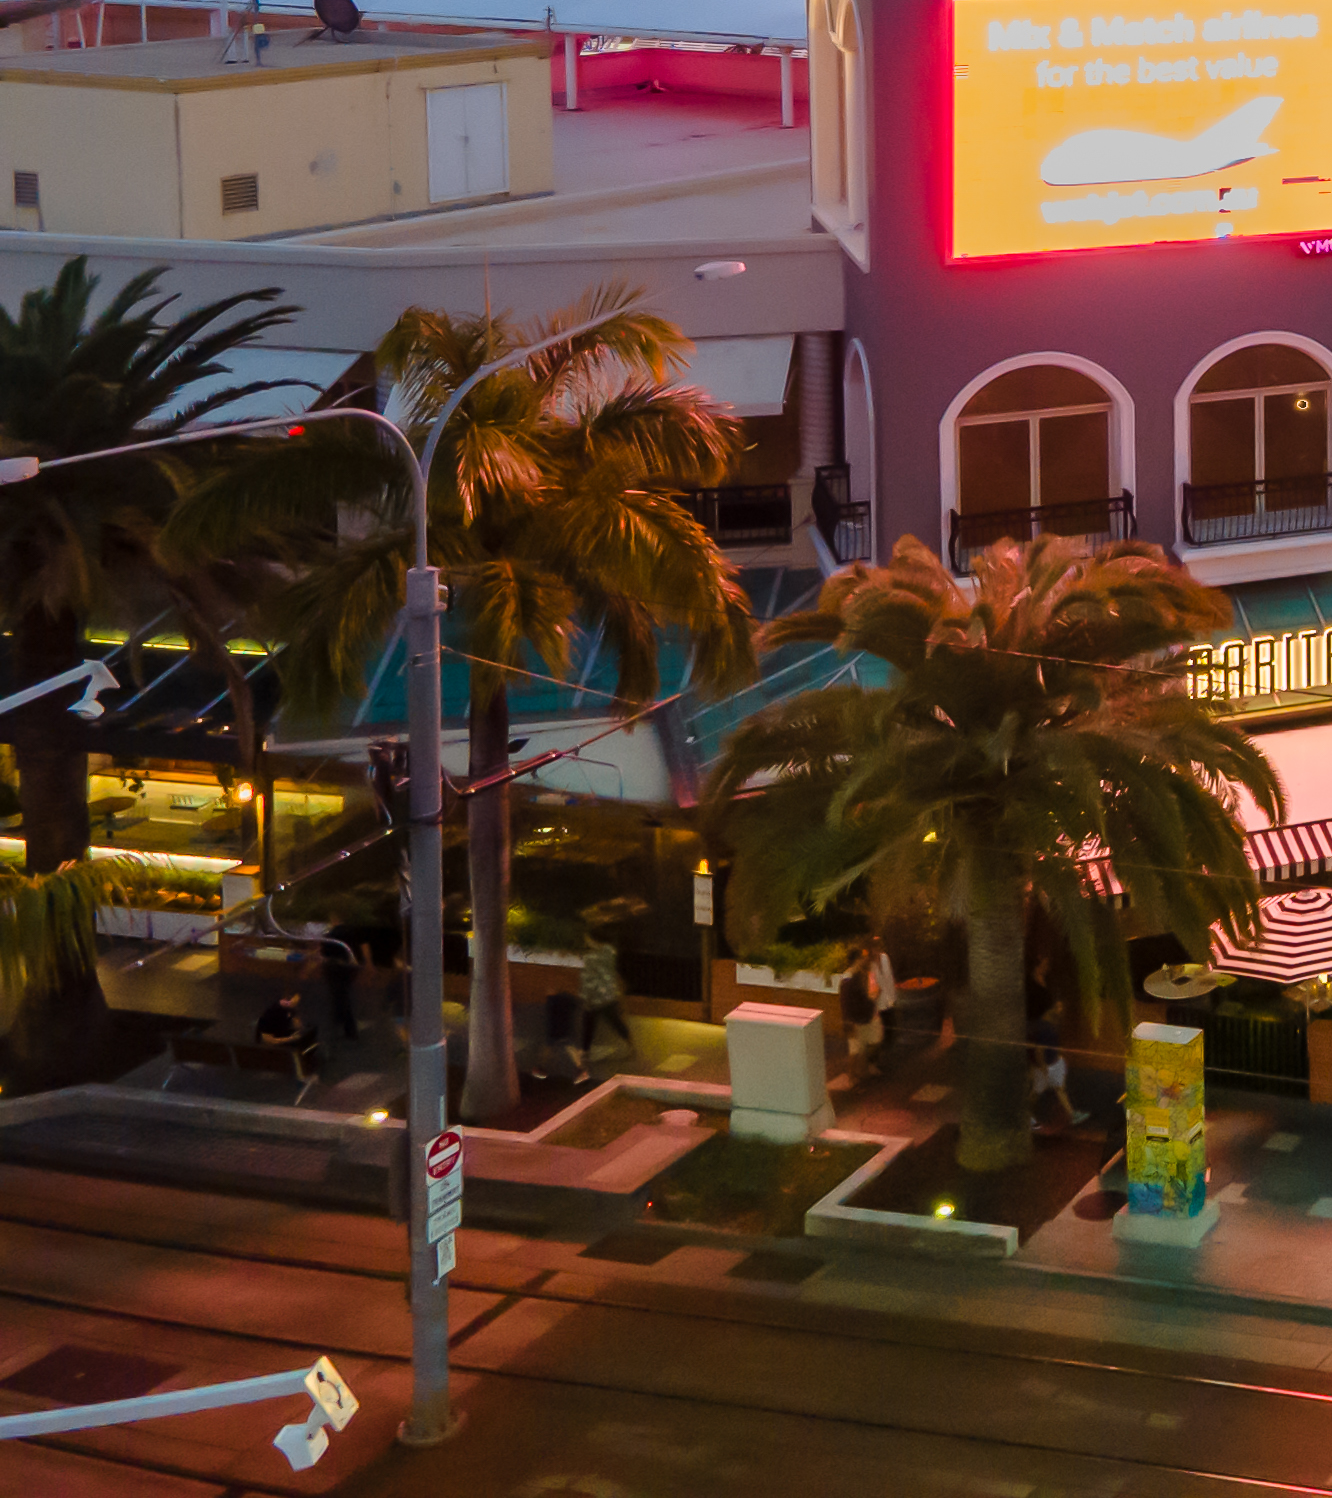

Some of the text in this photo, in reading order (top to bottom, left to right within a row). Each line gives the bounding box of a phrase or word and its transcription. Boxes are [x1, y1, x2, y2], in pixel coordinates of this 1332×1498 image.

[1058, 17, 1084, 48] &
[1091, 13, 1195, 47] Match
[1203, 10, 1319, 43] airlines
[1036, 52, 1278, 88] for the best value
